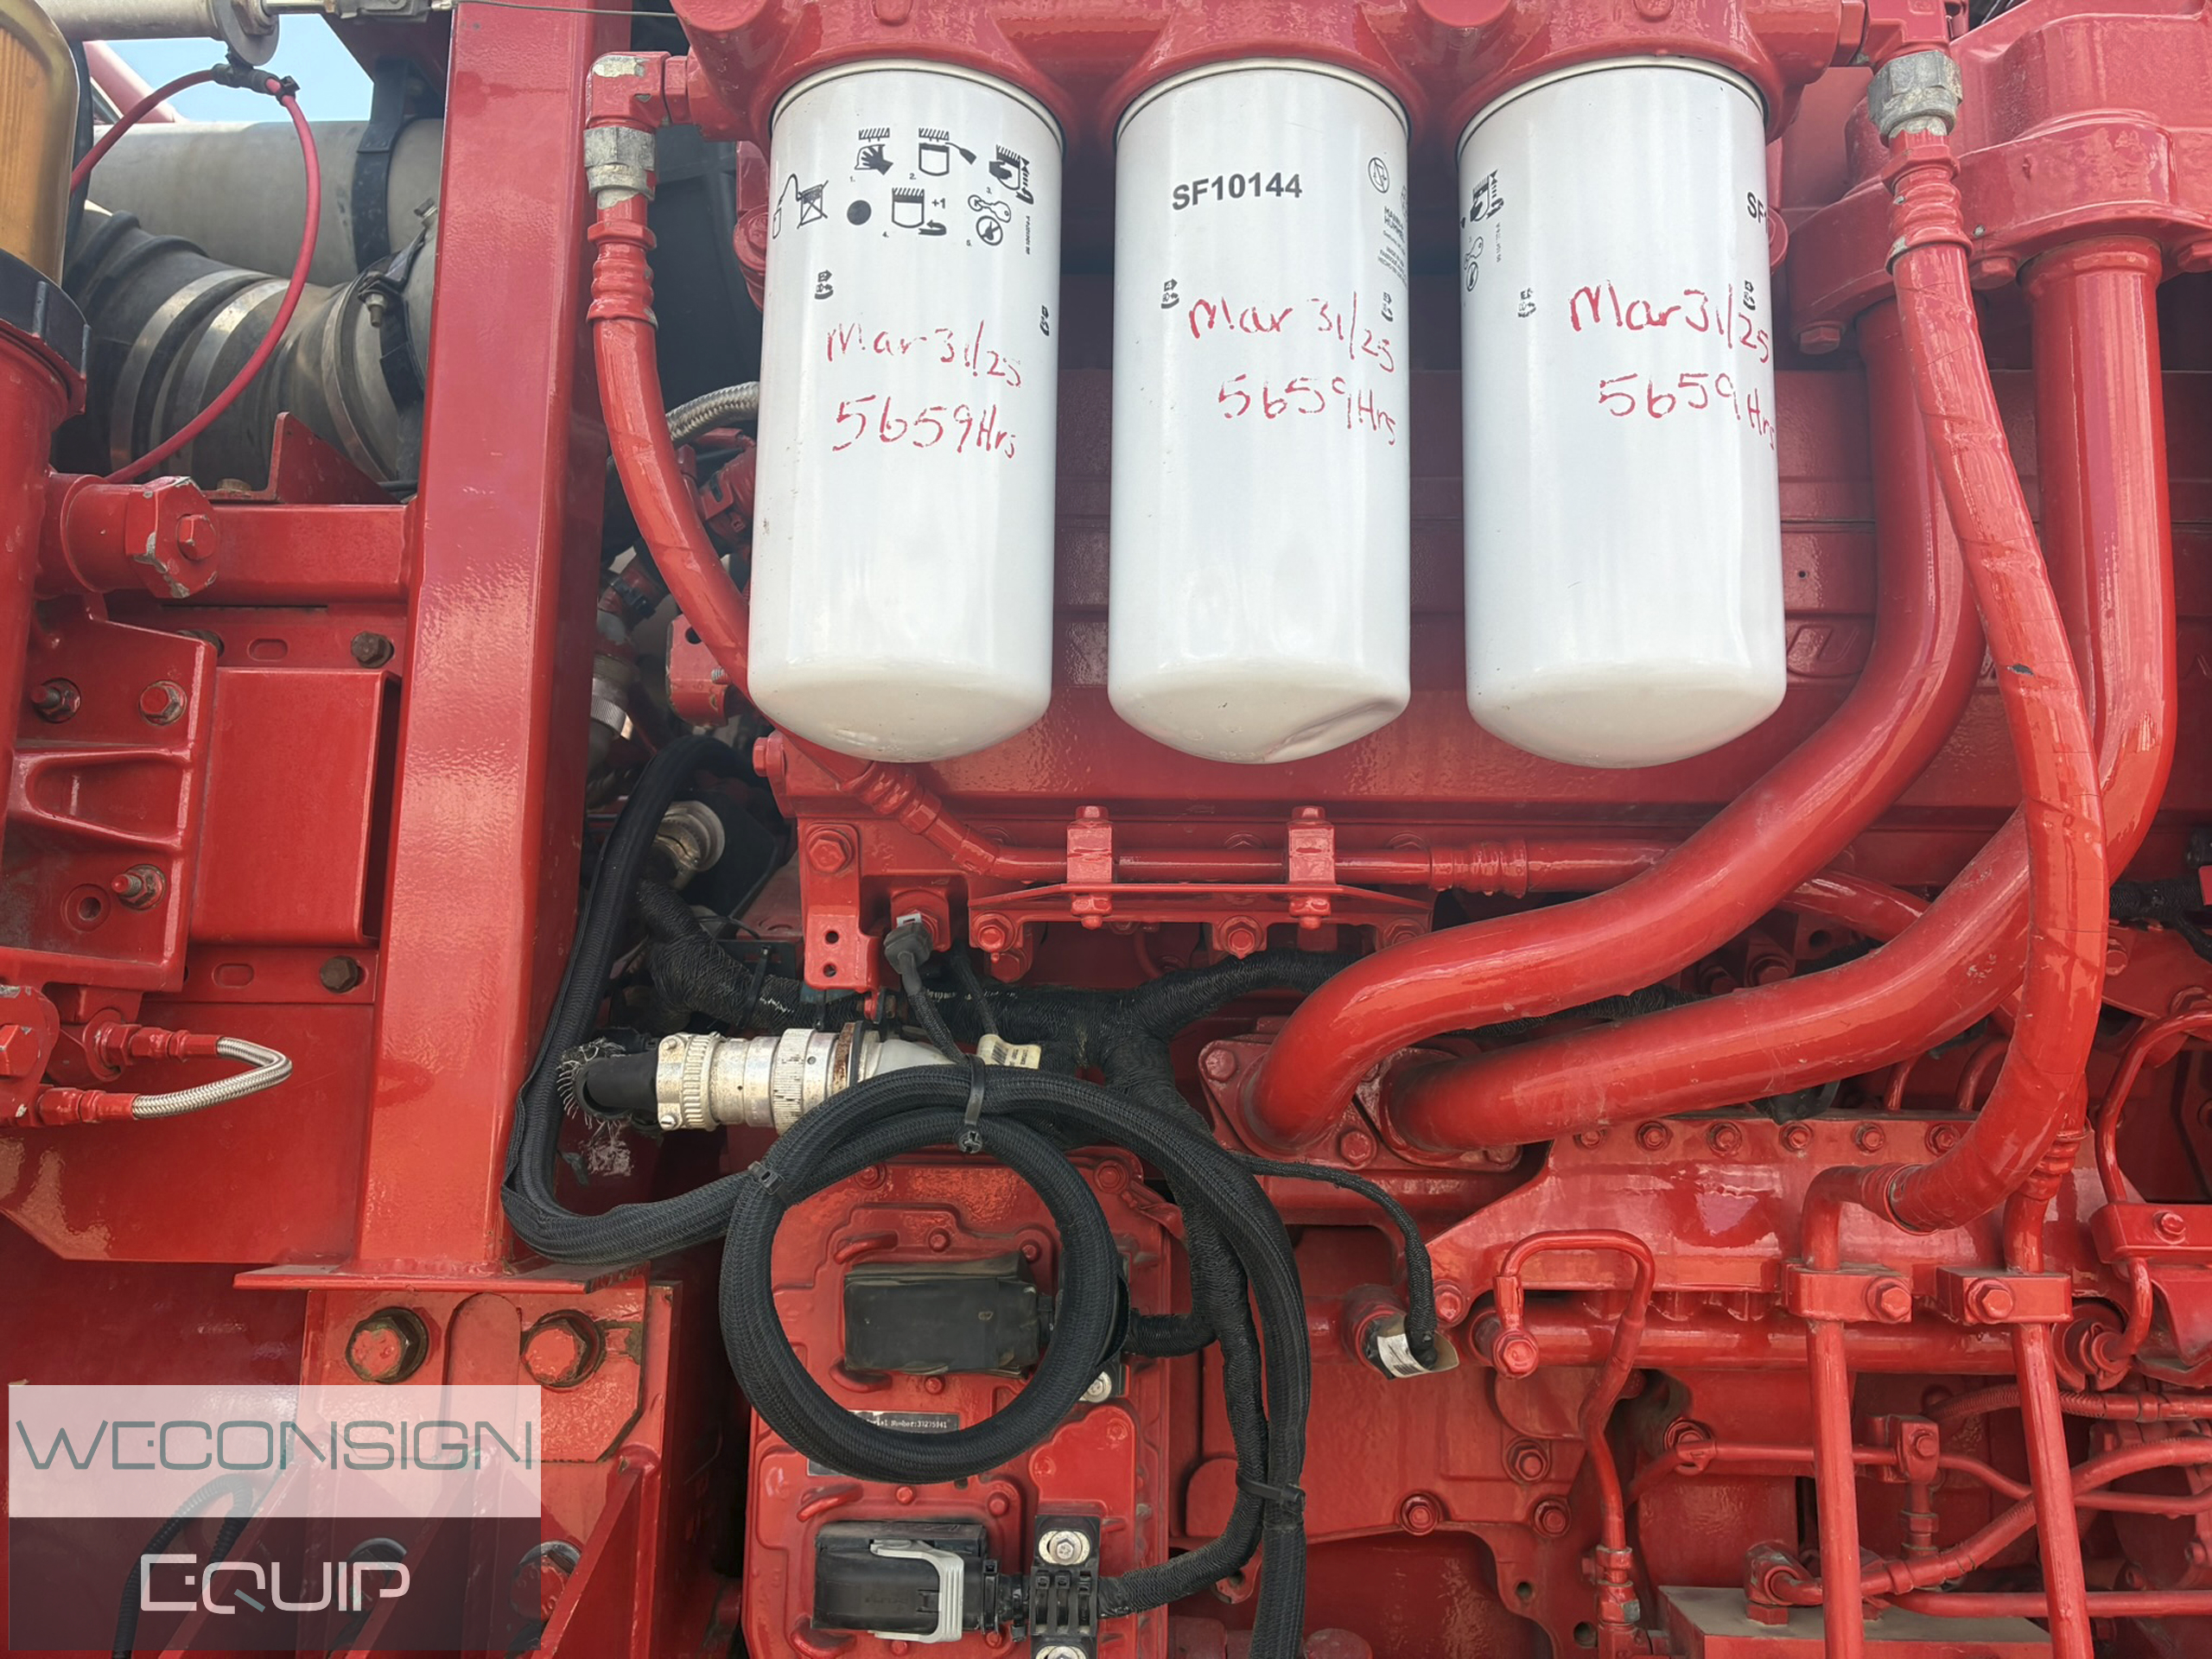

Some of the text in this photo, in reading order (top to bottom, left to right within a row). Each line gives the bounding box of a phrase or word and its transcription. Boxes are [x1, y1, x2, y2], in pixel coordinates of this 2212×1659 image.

[931, 198, 946, 209] +1
[1172, 172, 1303, 211] SF10144
[1189, 296, 1294, 340] Mar
[1568, 279, 1681, 333] Mar
[826, 323, 928, 363] Mar
